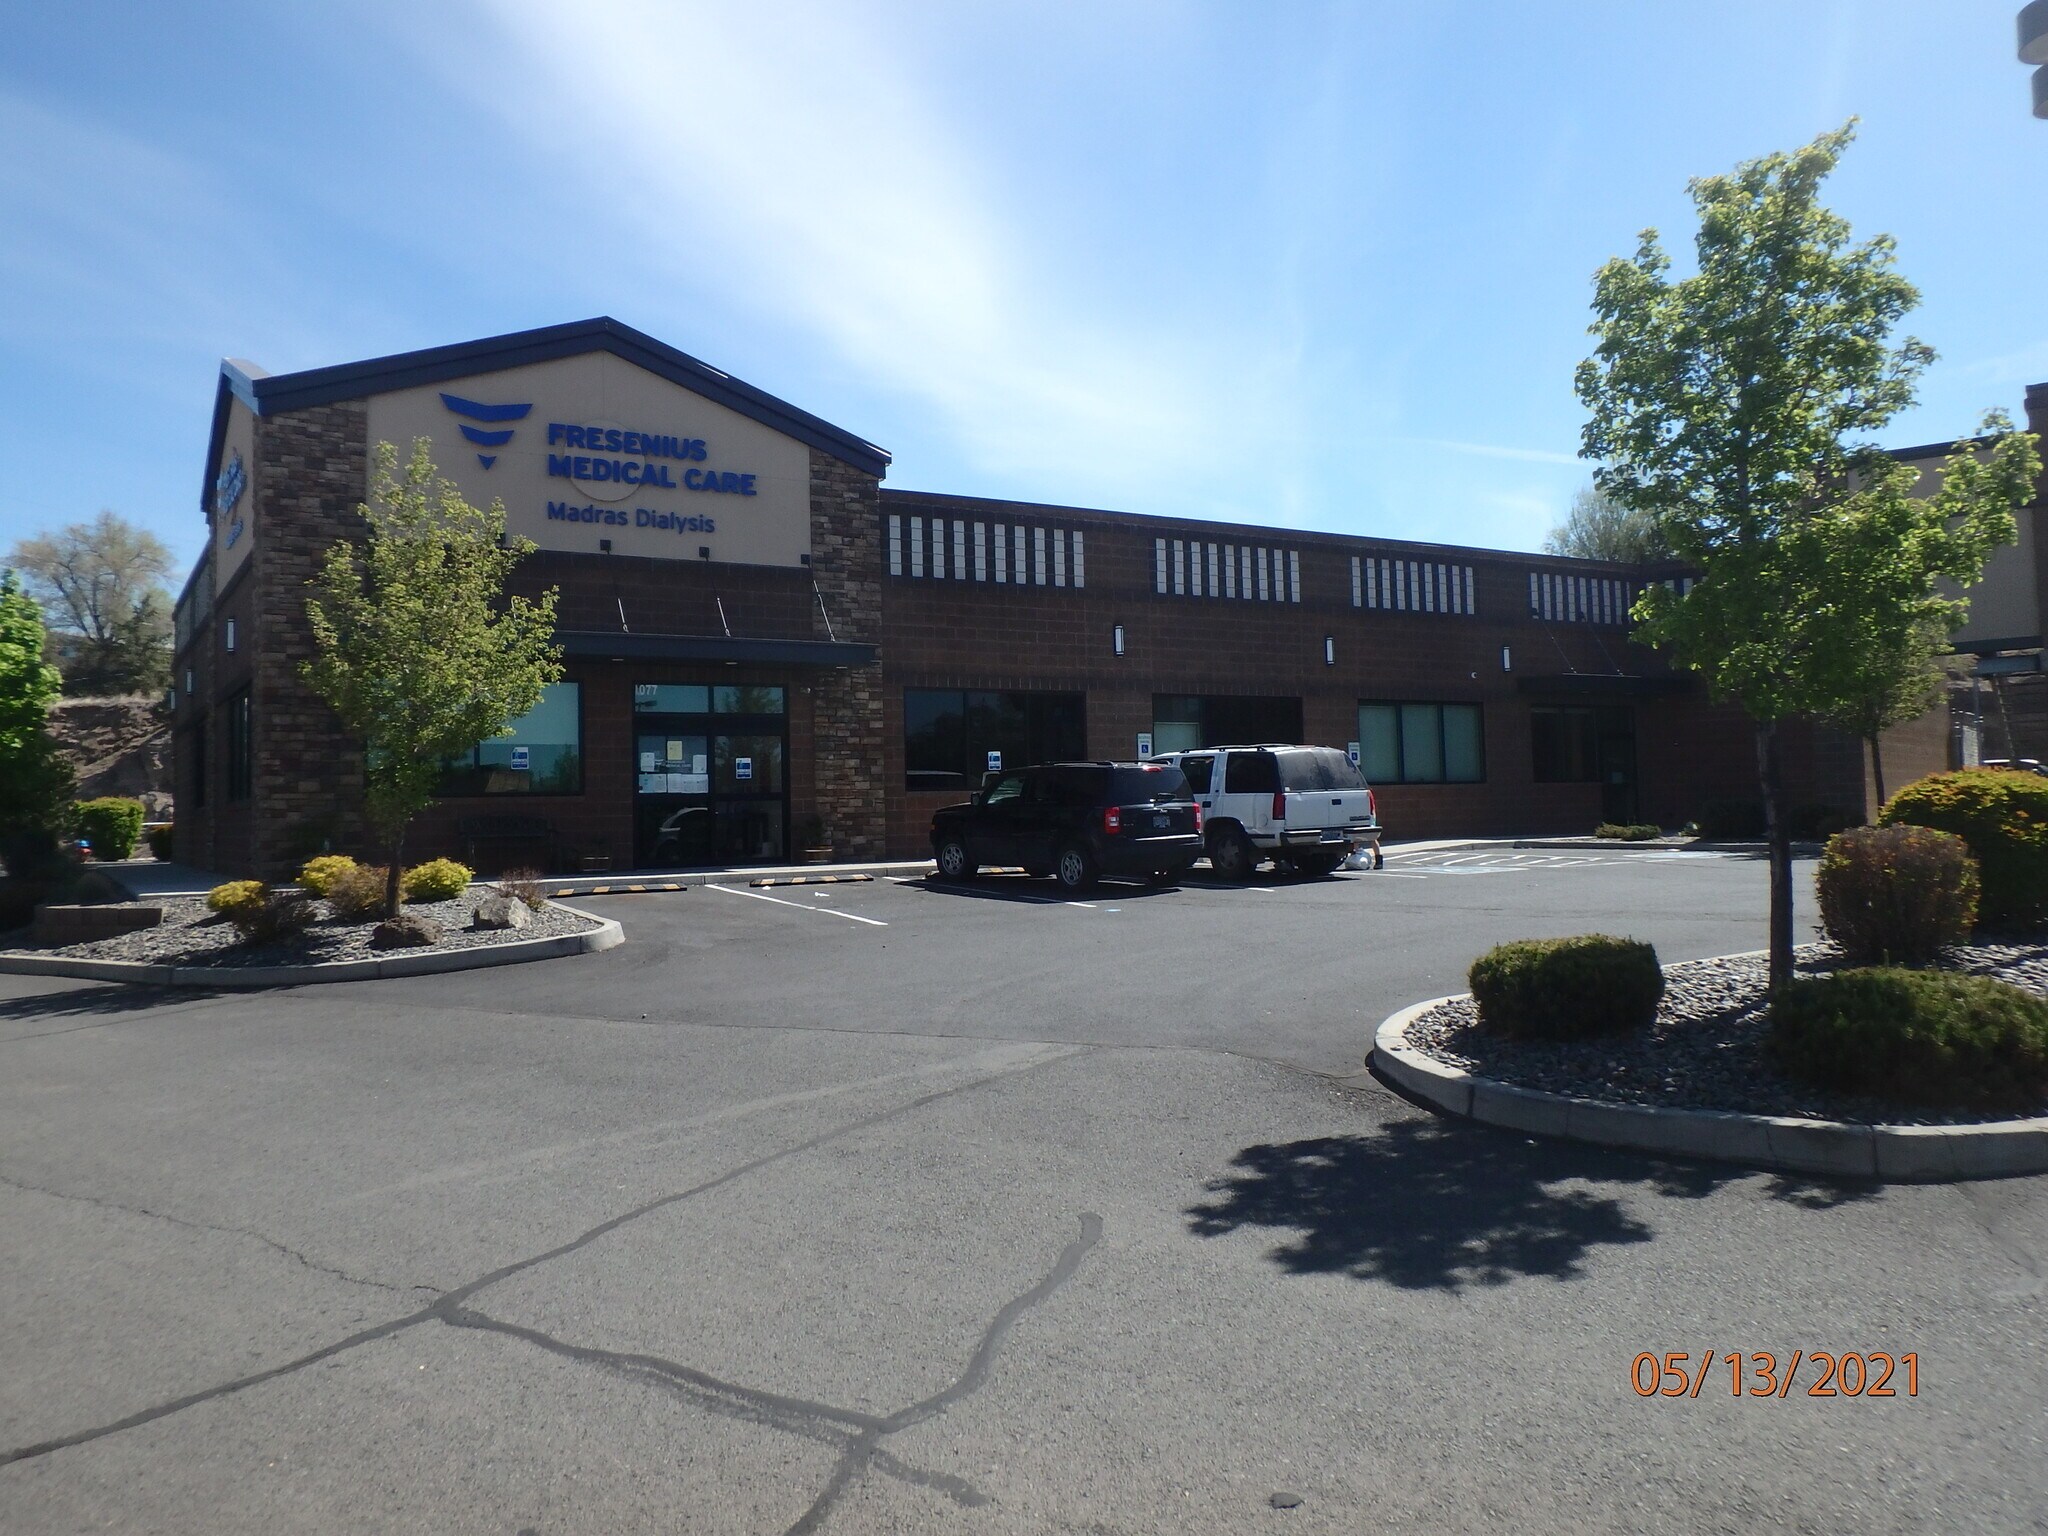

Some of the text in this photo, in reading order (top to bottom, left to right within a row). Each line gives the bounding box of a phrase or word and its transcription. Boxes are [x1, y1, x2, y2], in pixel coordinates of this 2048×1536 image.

[548, 423, 708, 461] FRESENIUS
[548, 454, 758, 496] MEDICAL CARE
[547, 501, 716, 535] Madras Dialysis
